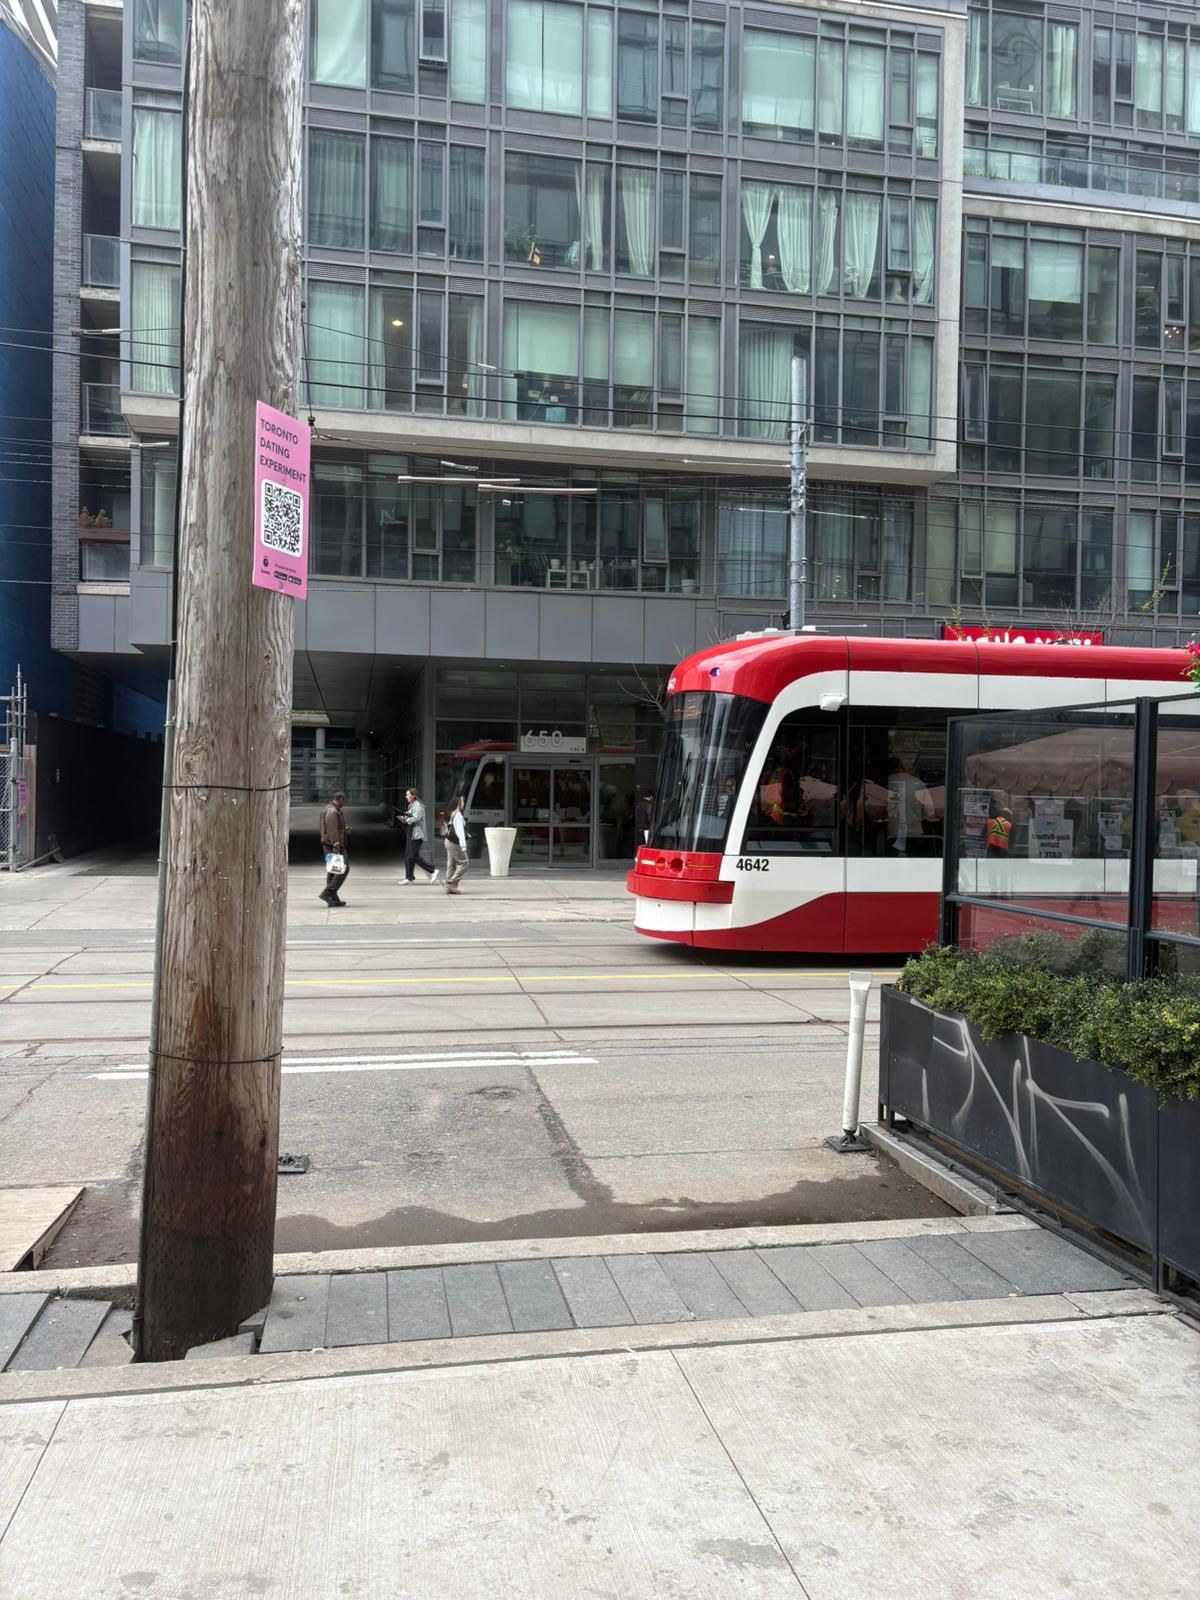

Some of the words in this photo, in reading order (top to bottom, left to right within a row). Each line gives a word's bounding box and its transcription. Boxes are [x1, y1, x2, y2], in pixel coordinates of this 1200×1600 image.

[260, 418, 299, 445] TORONTO
[260, 437, 290, 459] DATING
[260, 455, 306, 483] EXPERIMENT
[525, 729, 563, 746] 650
[736, 858, 770, 872] 4642
